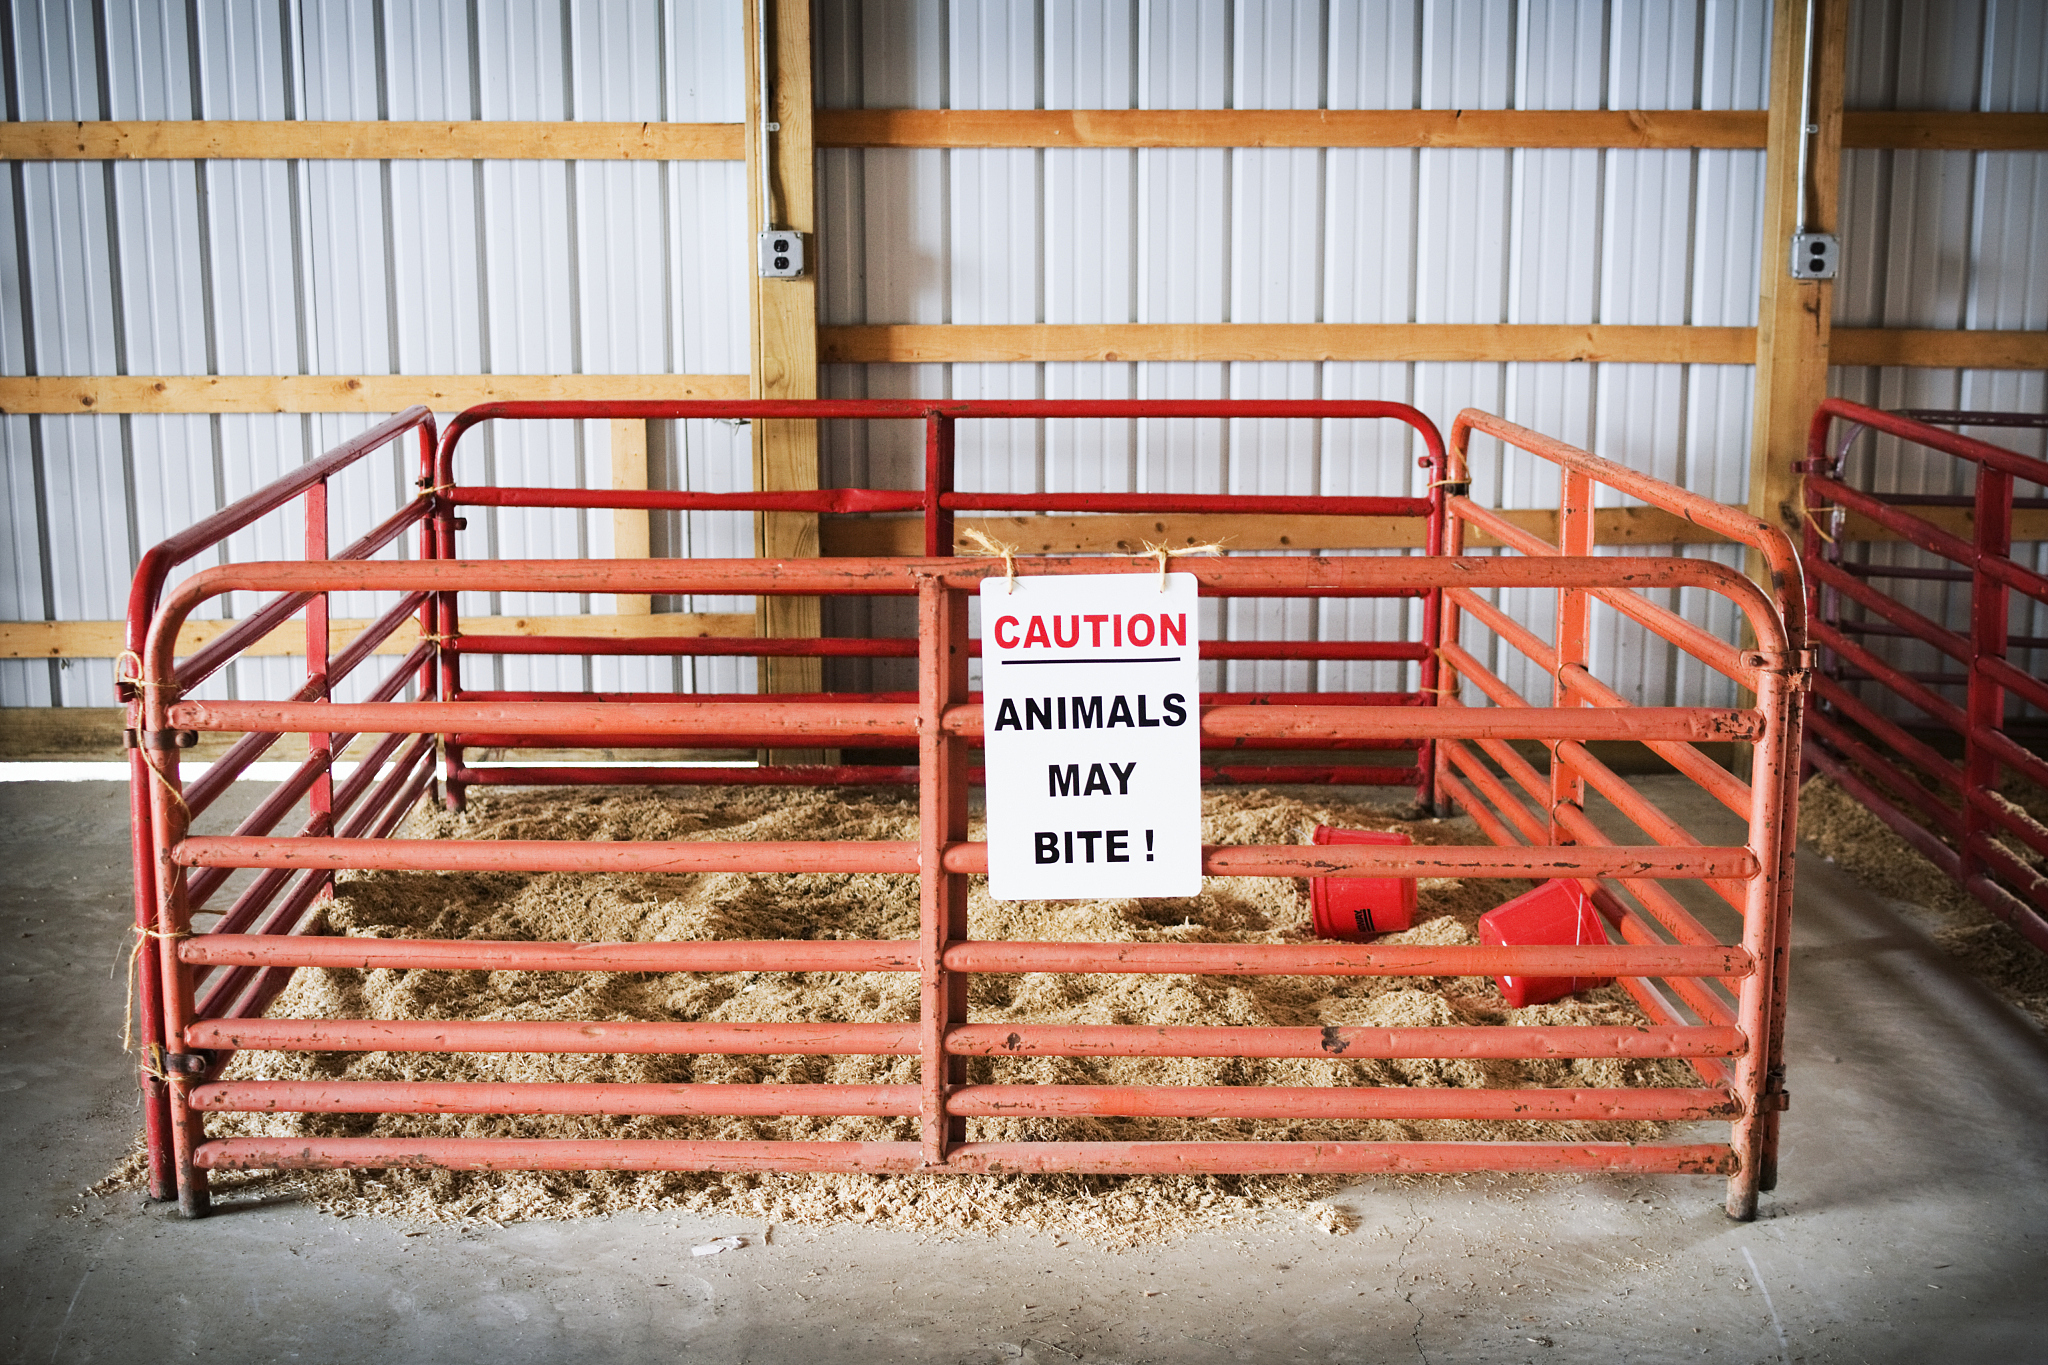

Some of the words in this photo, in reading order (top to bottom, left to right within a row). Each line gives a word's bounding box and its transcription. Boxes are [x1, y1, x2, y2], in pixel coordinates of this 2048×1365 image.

[994, 613, 1187, 649] CAUTION
[994, 693, 1187, 731] ANIMALS
[1048, 762, 1137, 797] MAY
[1034, 829, 1130, 864] BITE
